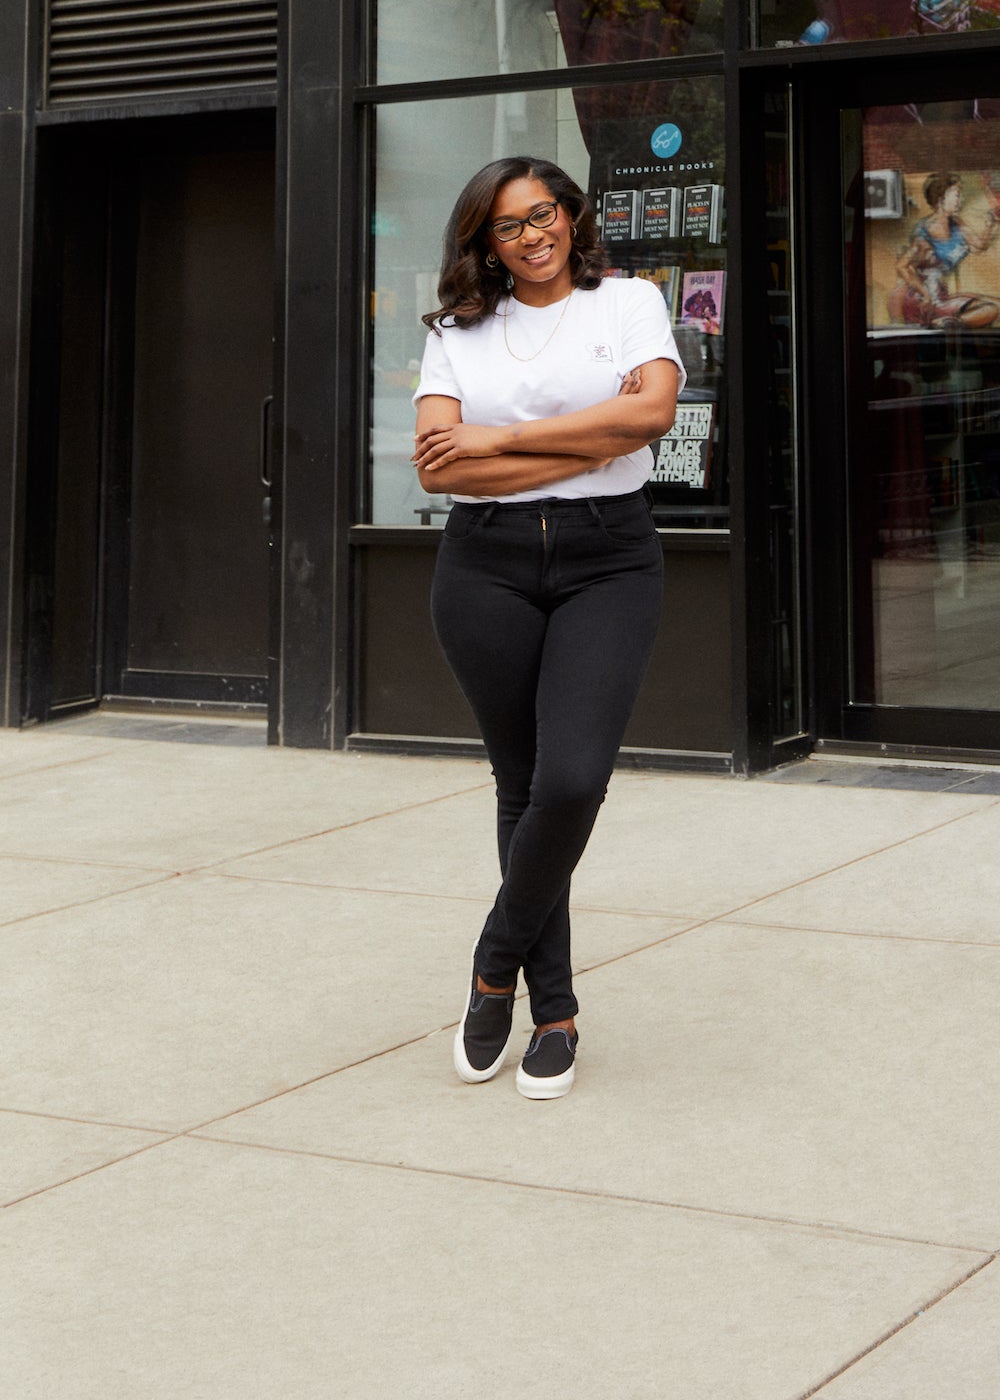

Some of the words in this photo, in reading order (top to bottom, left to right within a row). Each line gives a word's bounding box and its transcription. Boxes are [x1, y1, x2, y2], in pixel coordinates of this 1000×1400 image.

[615, 164, 674, 175] CHRONICLE
[679, 161, 714, 171] BOOKS
[690, 276, 705, 285] WASH
[705, 275, 716, 284] DAY
[659, 440, 703, 456] BLACK
[656, 456, 702, 471] POWER
[649, 470, 705, 486] KITCHEN
